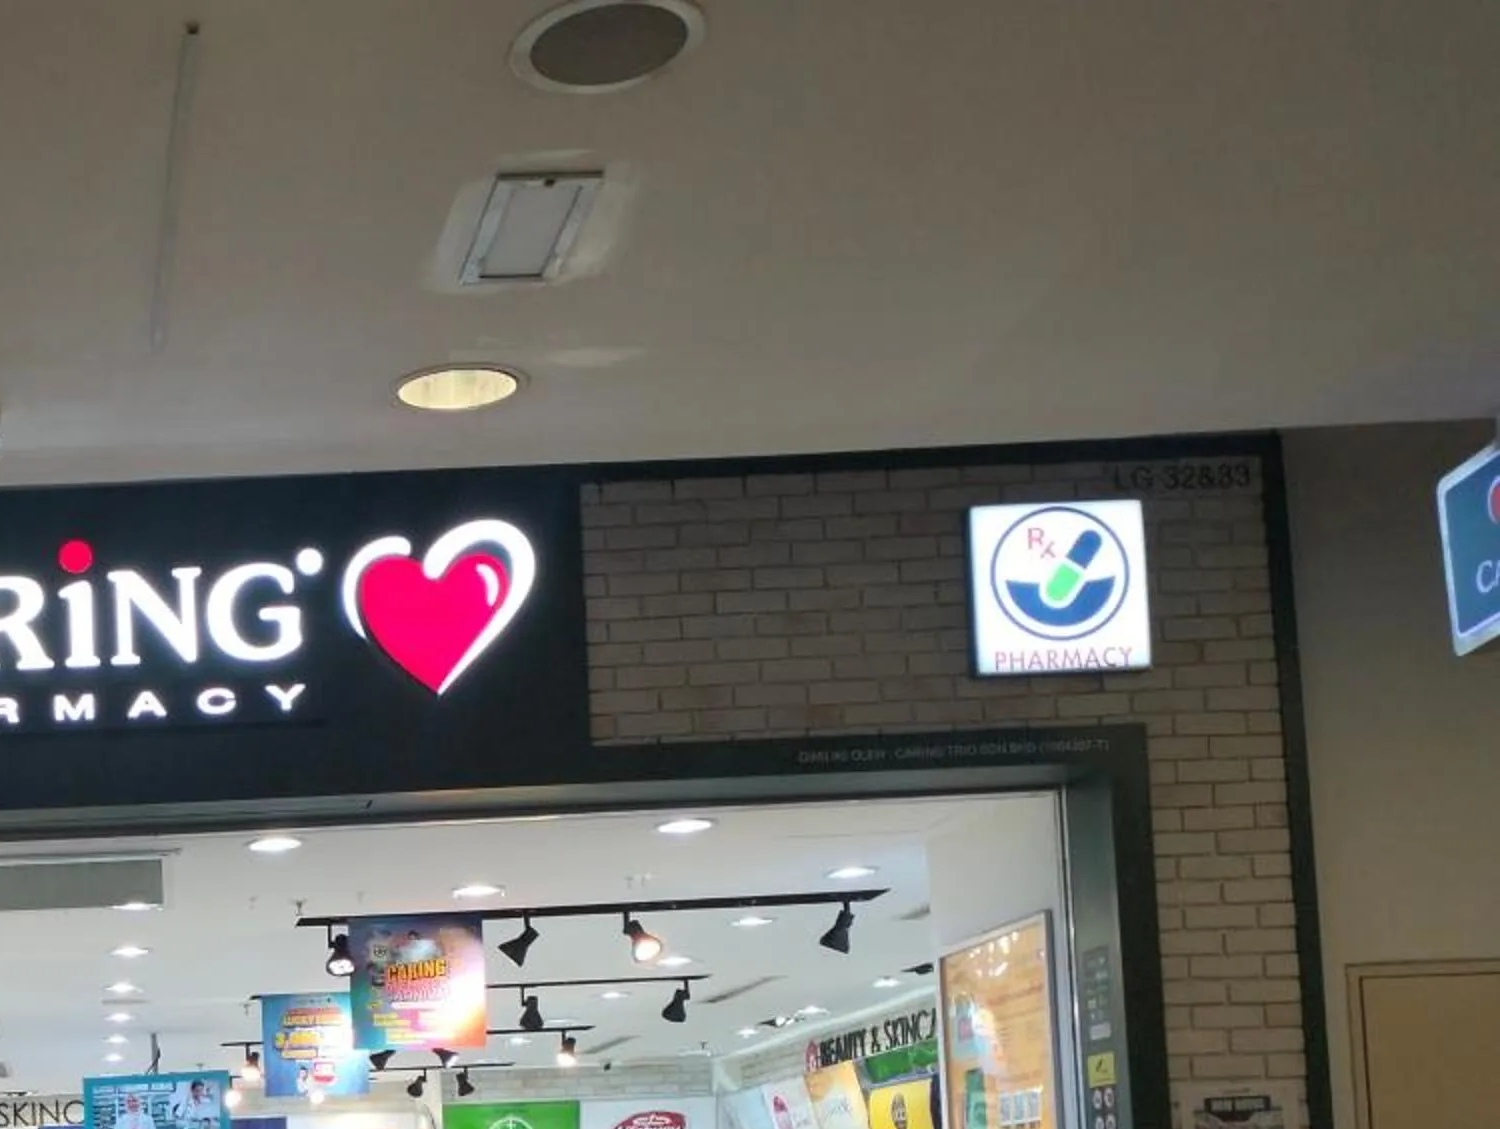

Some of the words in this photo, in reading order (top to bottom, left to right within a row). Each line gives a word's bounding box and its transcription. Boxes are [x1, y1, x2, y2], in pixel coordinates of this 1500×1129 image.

[1113, 465, 1154, 490] LG
[994, 646, 1134, 671] PHARMACY
[0, 1100, 84, 1128] SKINC
